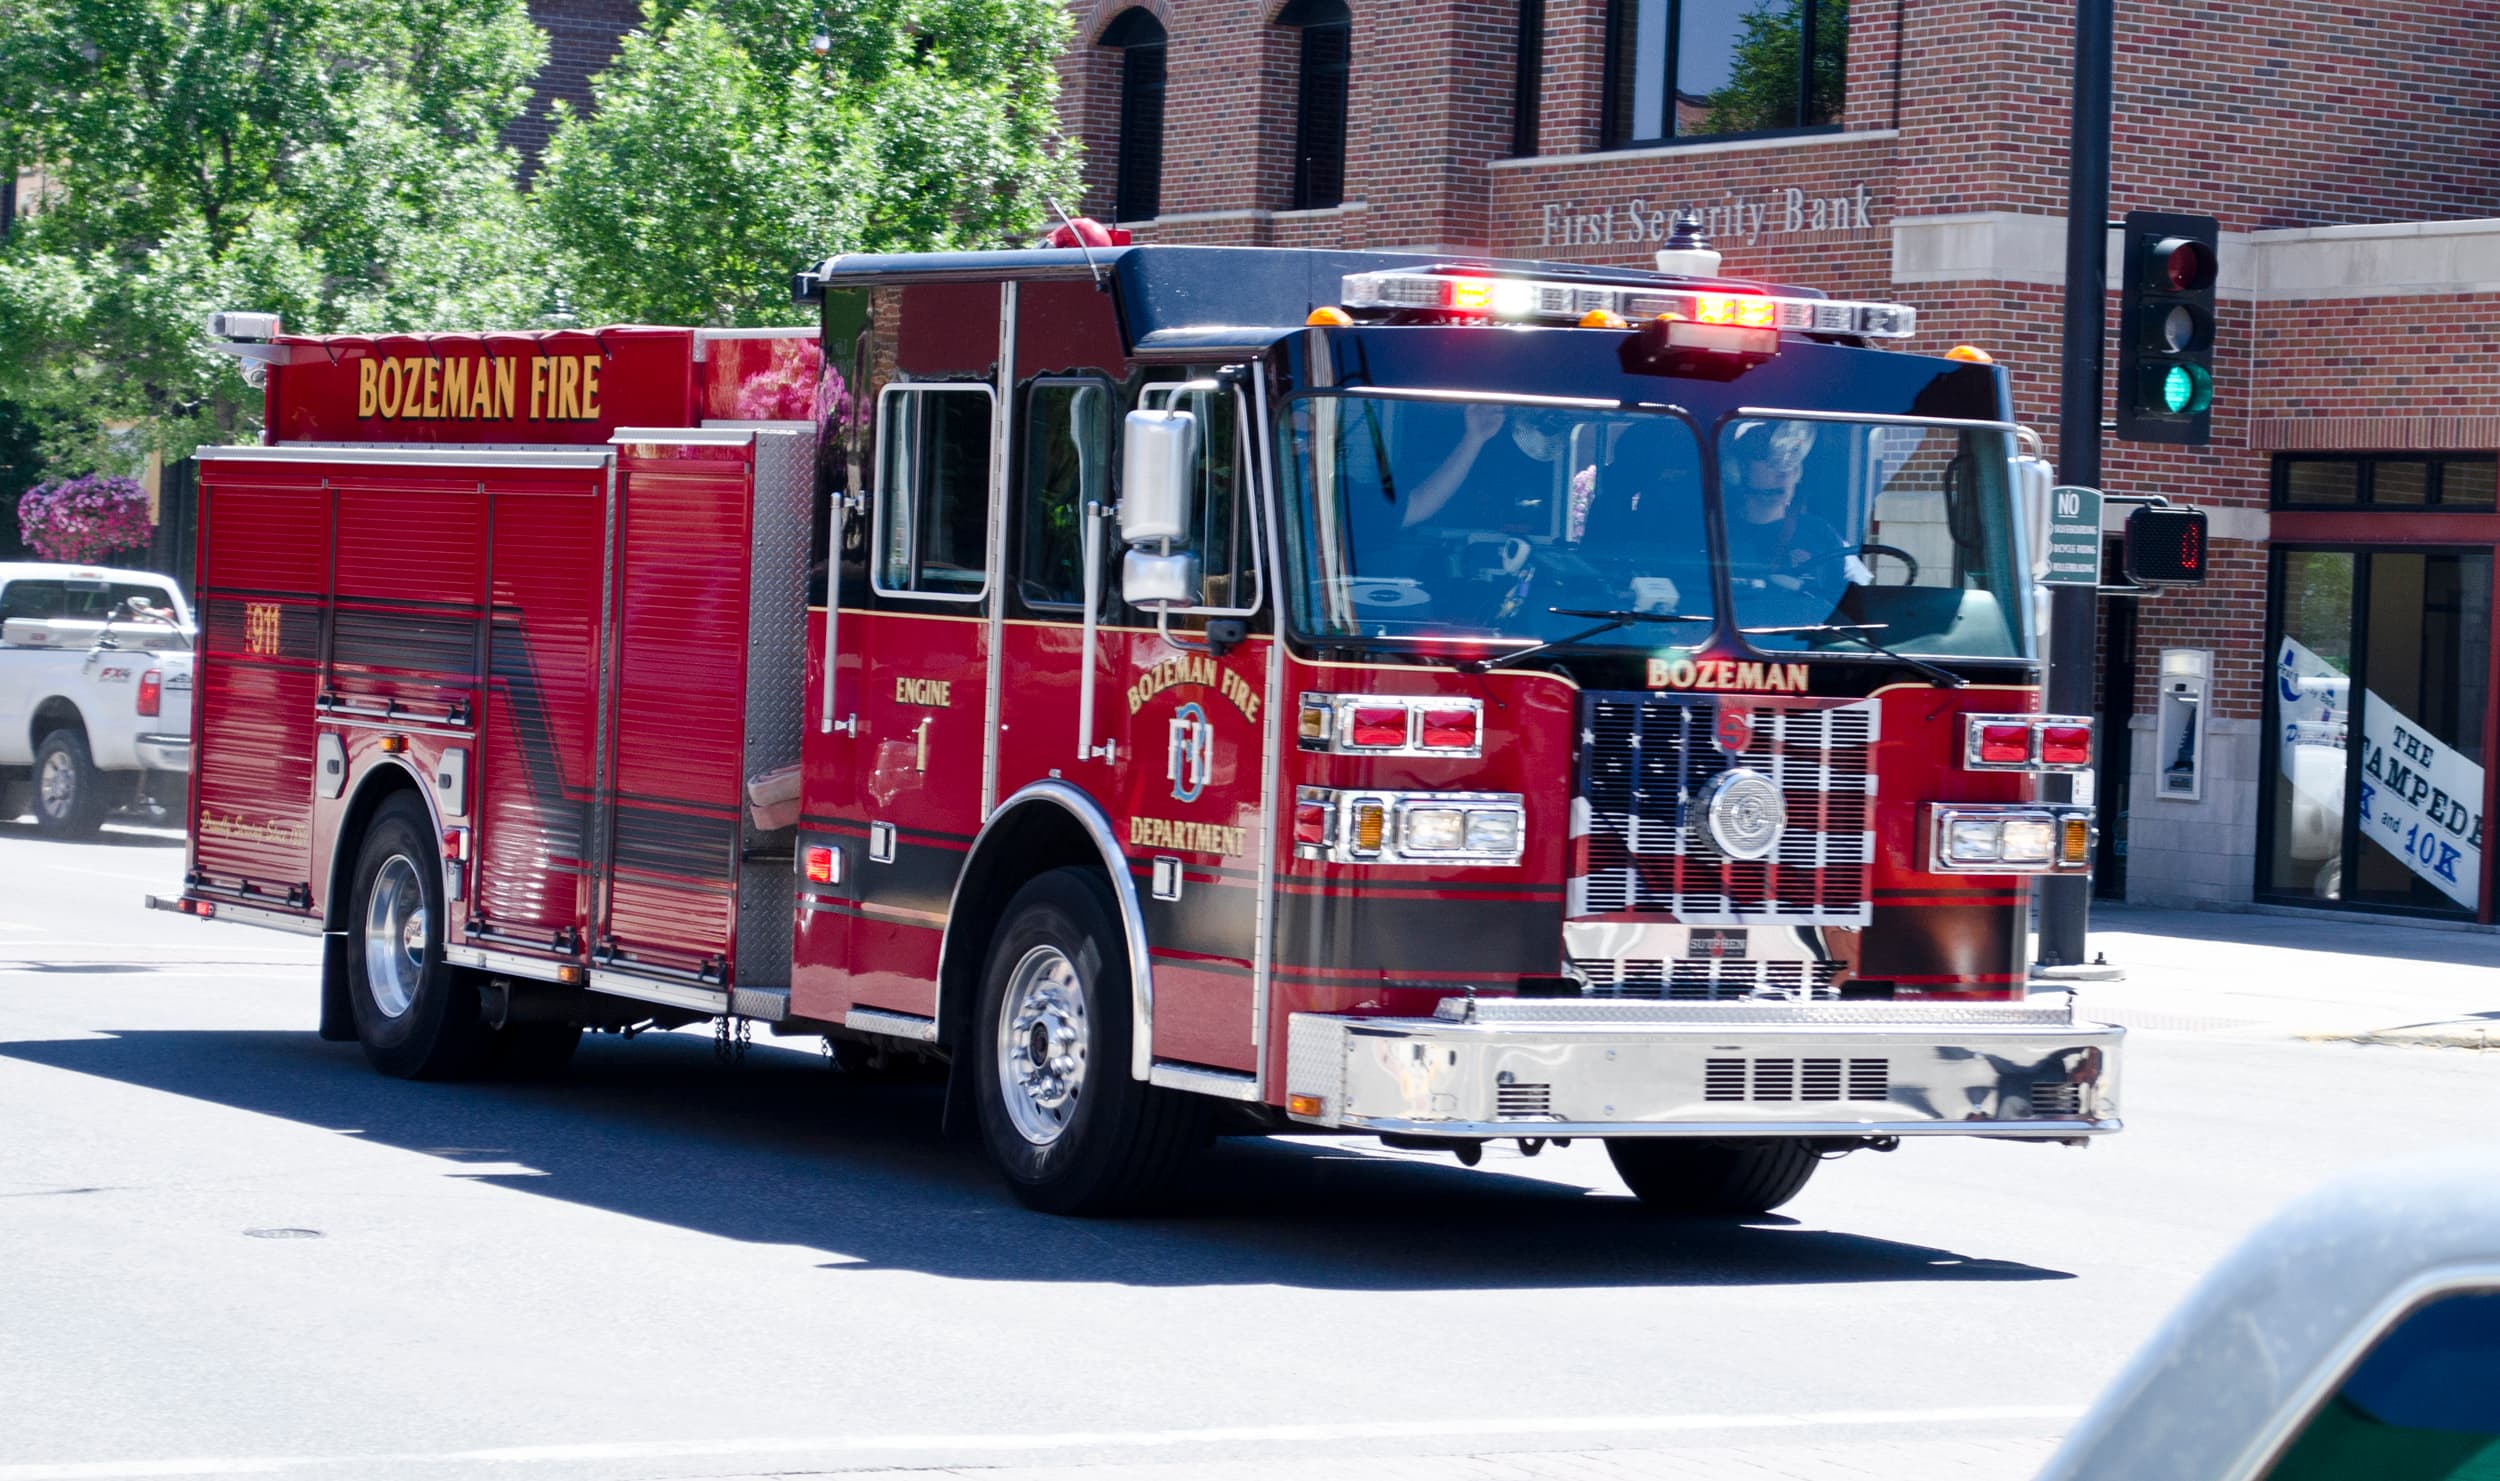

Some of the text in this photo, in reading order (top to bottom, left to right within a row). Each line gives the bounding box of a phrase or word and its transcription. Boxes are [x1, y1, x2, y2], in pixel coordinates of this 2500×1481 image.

[1542, 202, 1615, 246] First
[1784, 184, 1873, 232] Bank
[358, 355, 600, 421] BOZEMAN FIRE
[2057, 494, 2080, 515] NO
[896, 677, 951, 708] ENGINE
[1126, 655, 1261, 723] BOZEMAN FIRE
[1647, 658, 1809, 692] BOZEMAN
[913, 719, 929, 772] 1
[2393, 726, 2434, 768] THE
[1130, 816, 1246, 857] DEPARTMENT
[2381, 812, 2402, 833] and
[2405, 823, 2462, 882] 10K
